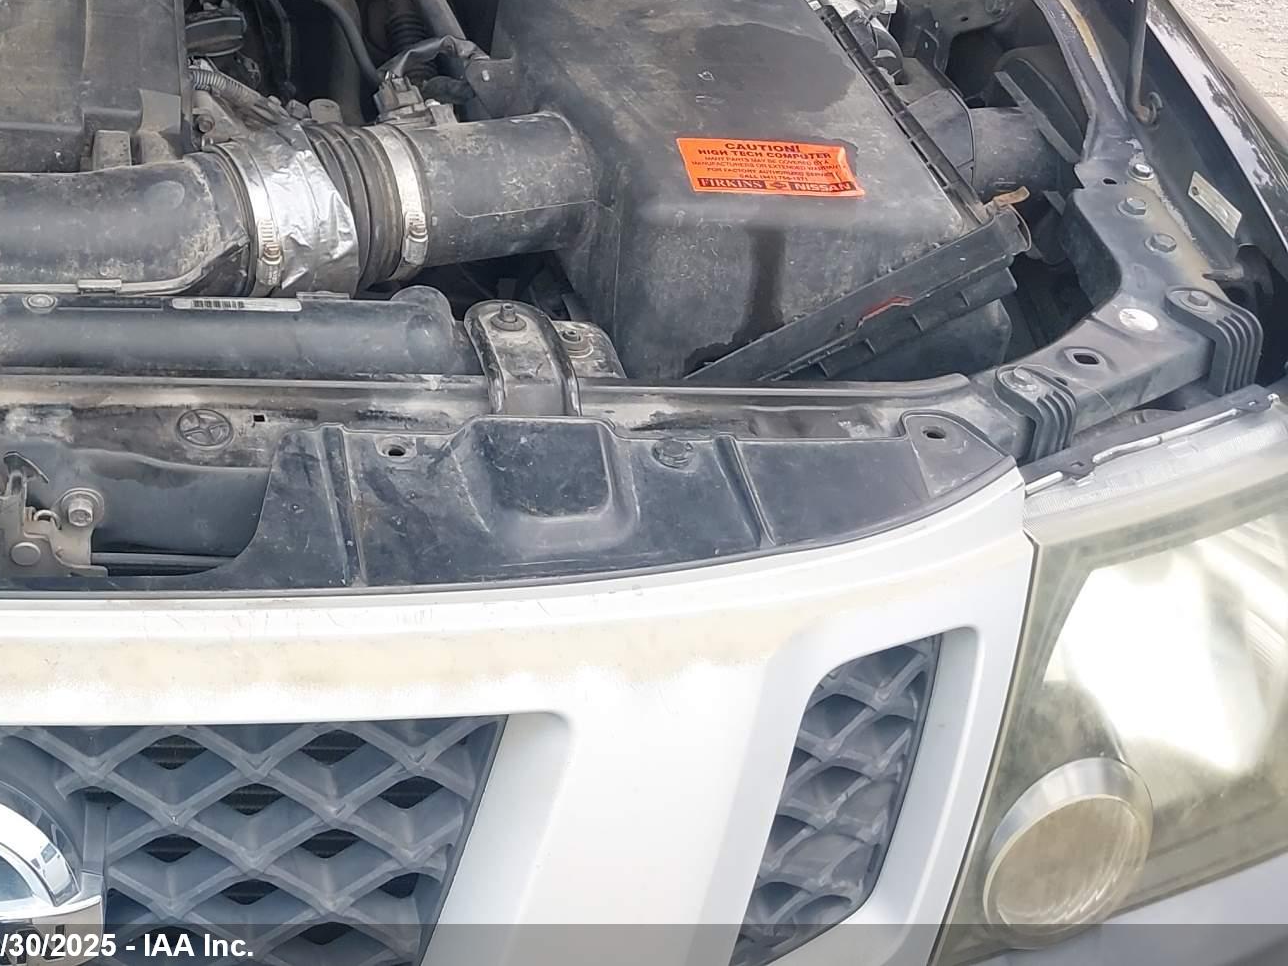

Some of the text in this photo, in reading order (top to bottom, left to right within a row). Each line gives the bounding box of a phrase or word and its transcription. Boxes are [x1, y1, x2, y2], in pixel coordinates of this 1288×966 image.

[725, 142, 801, 153] CAUTION!
[698, 148, 728, 156] HIGH
[766, 152, 832, 160] COMPUTER
[700, 179, 851, 191] FIRKINS NISSAN
